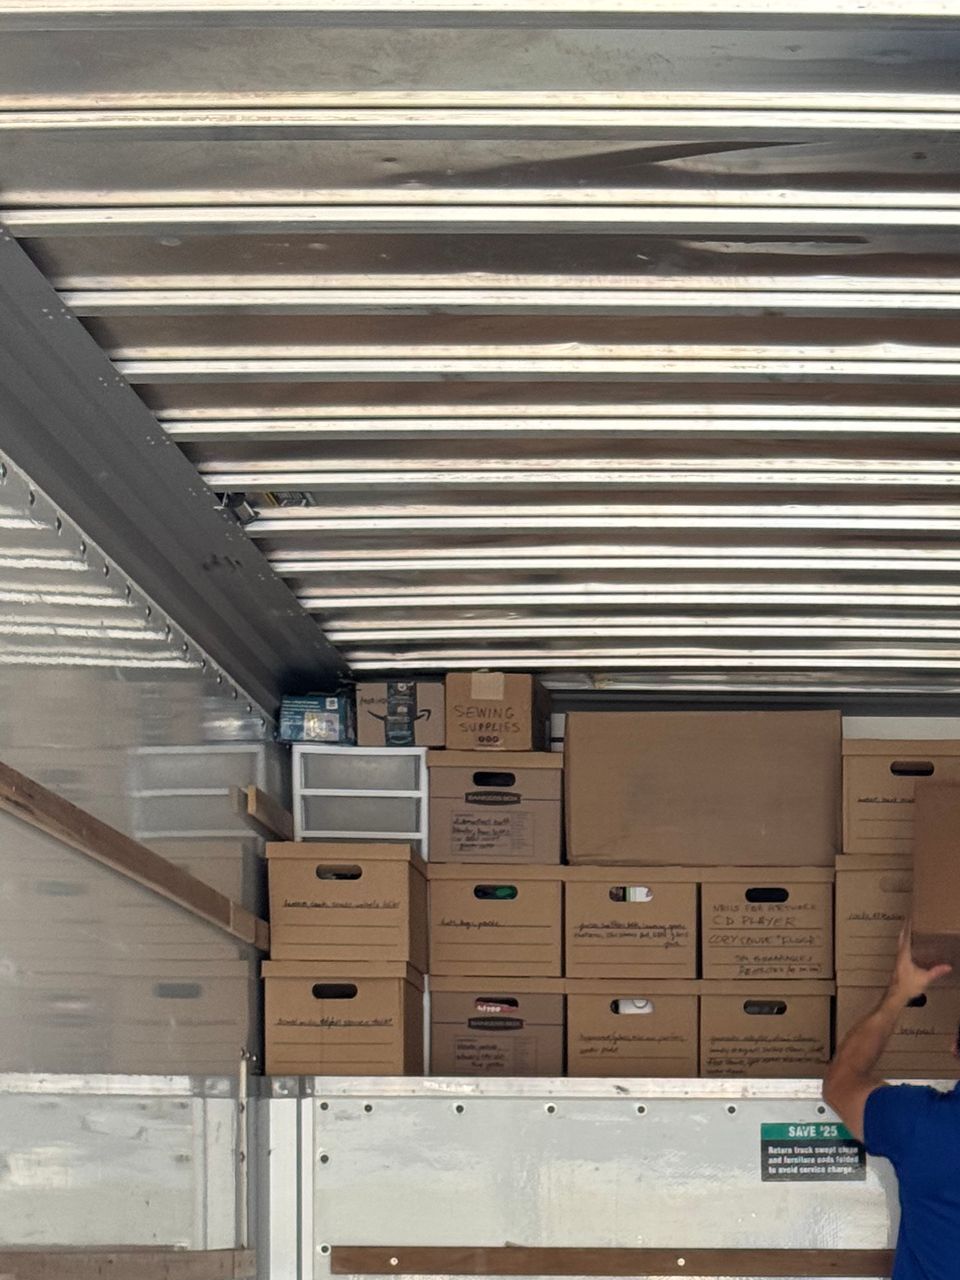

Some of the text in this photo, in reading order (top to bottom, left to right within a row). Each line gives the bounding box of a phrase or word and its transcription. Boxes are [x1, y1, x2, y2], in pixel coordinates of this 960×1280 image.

[454, 704, 515, 720] SEWING
[459, 721, 521, 734] SUPPLIES
[742, 915, 796, 927] PLAYER
[788, 1126, 816, 1137] SAVE
[768, 1146, 859, 1155] Return truck swept clean
[768, 1156, 782, 1164] and
[784, 1156, 815, 1164] furniture
[836, 1156, 859, 1164] folded
[768, 1166, 777, 1174] to
[778, 1166, 798, 1174] avoid
[800, 1166, 826, 1174] service
